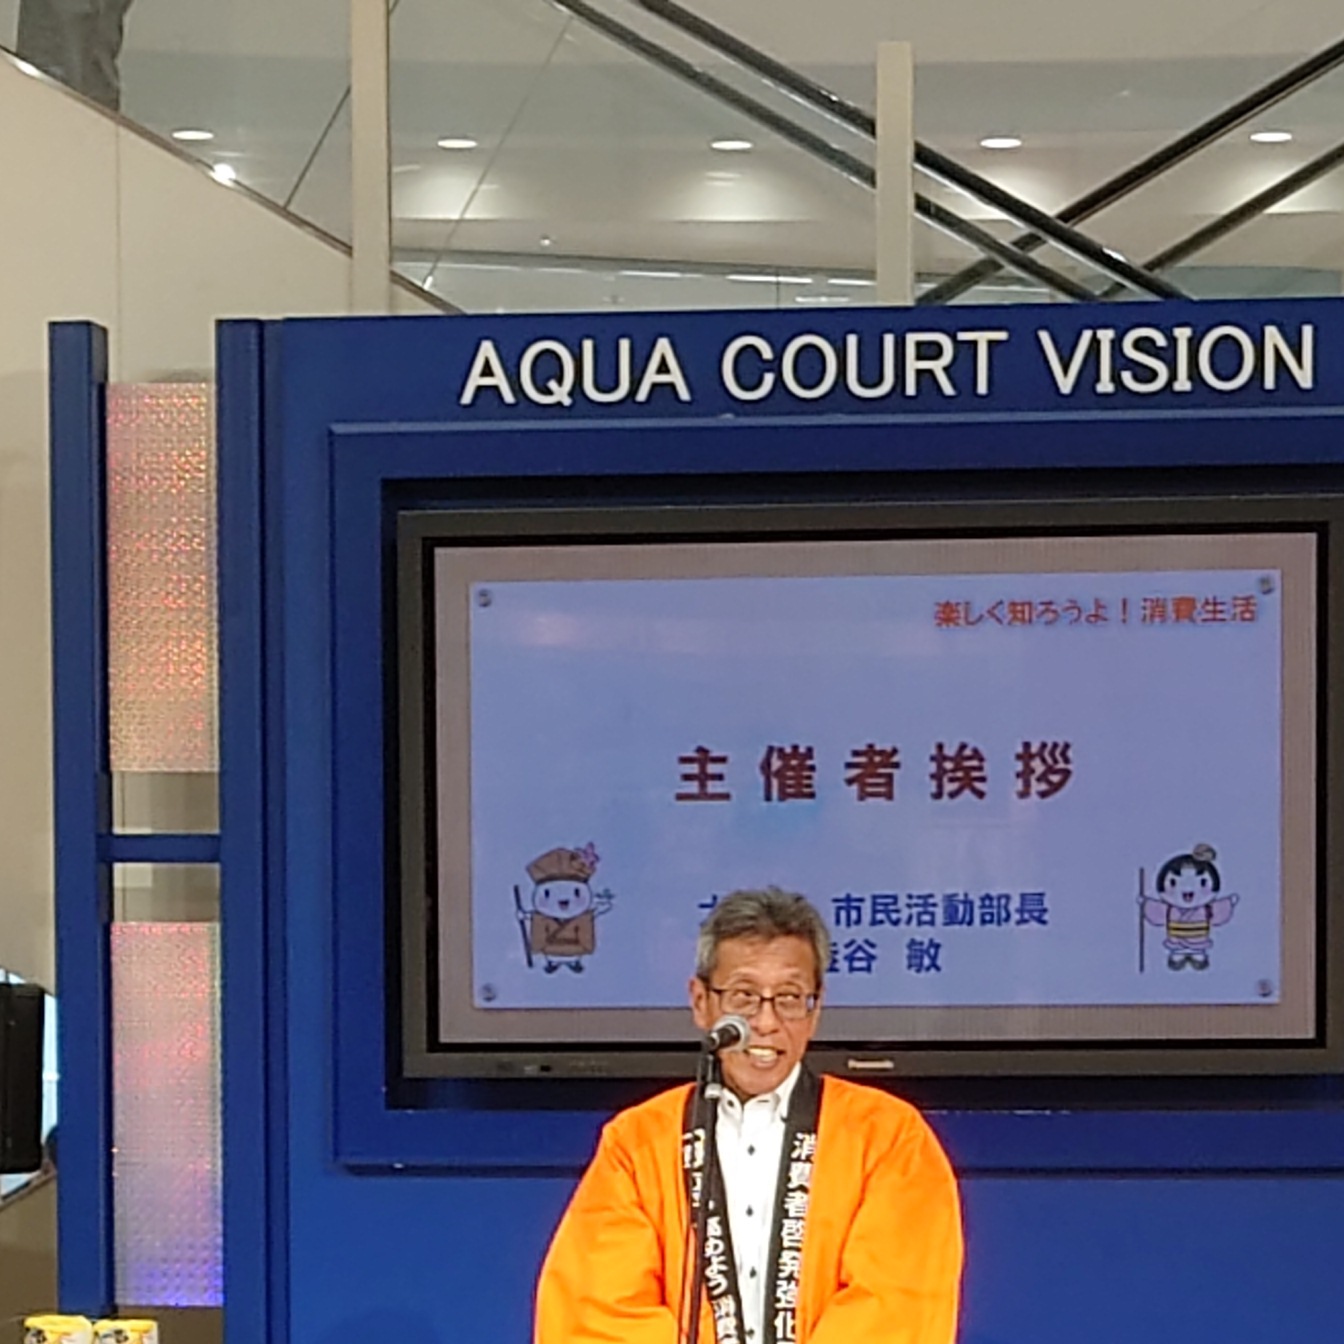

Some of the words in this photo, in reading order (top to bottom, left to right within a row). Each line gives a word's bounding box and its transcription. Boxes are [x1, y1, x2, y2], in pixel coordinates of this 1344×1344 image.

[459, 337, 693, 407] AQUA
[720, 329, 1010, 401] COURT
[1037, 323, 1316, 396] VISION
[674, 741, 1074, 803] 主催者挨拶
[831, 892, 1050, 931] 市民活動部長
[905, 938, 943, 975] 敏
